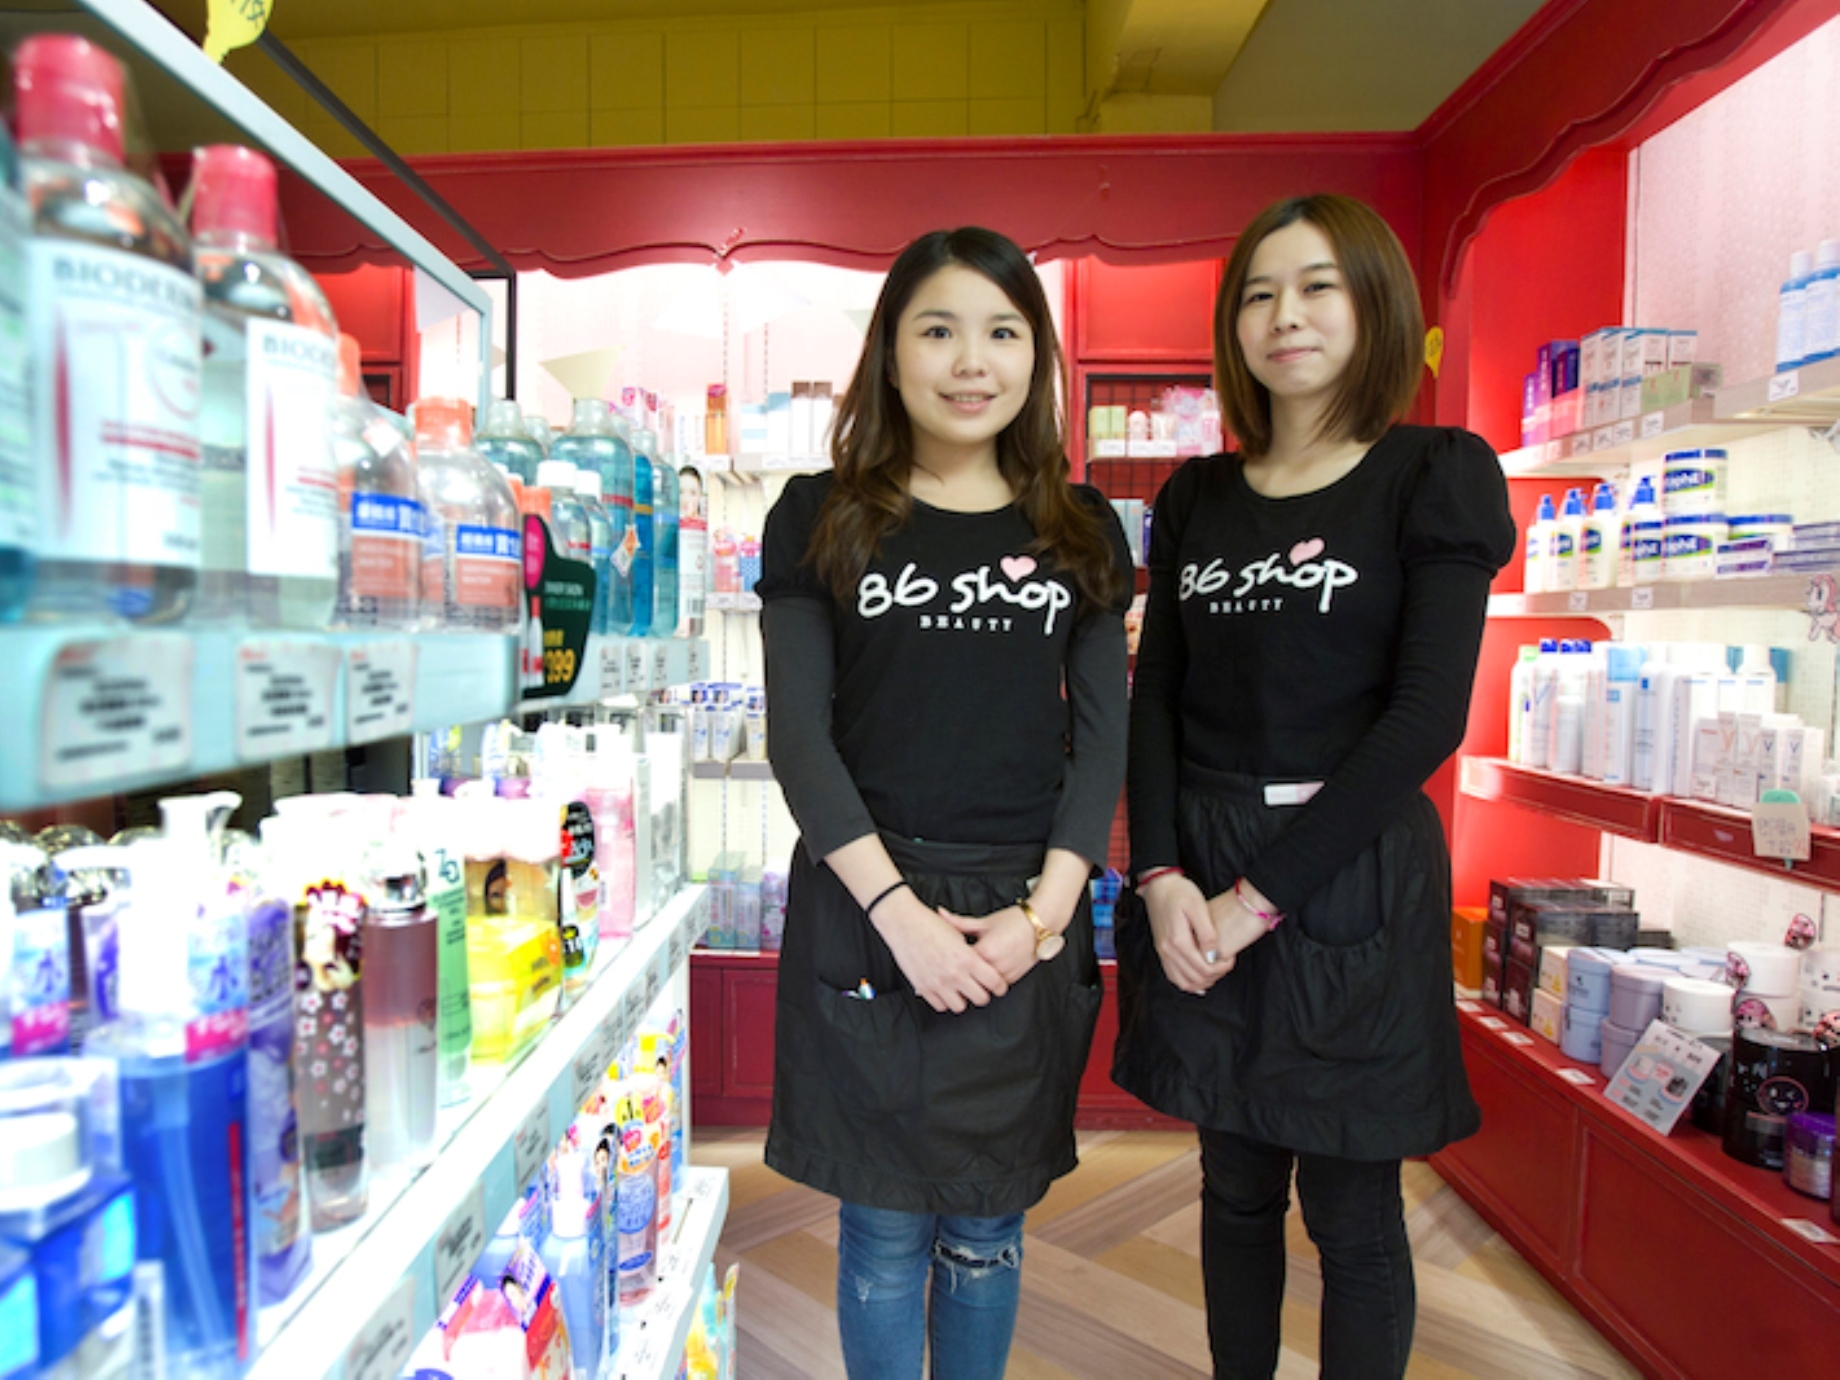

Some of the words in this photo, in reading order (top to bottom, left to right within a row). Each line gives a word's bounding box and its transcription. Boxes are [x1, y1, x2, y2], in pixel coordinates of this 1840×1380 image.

[858, 563, 938, 618] 86
[949, 565, 1071, 634] shop
[1179, 558, 1230, 601] 86
[1233, 553, 1358, 613] shop
[919, 615, 1013, 632] BEAUTY
[1209, 598, 1283, 614] BEAUTY
